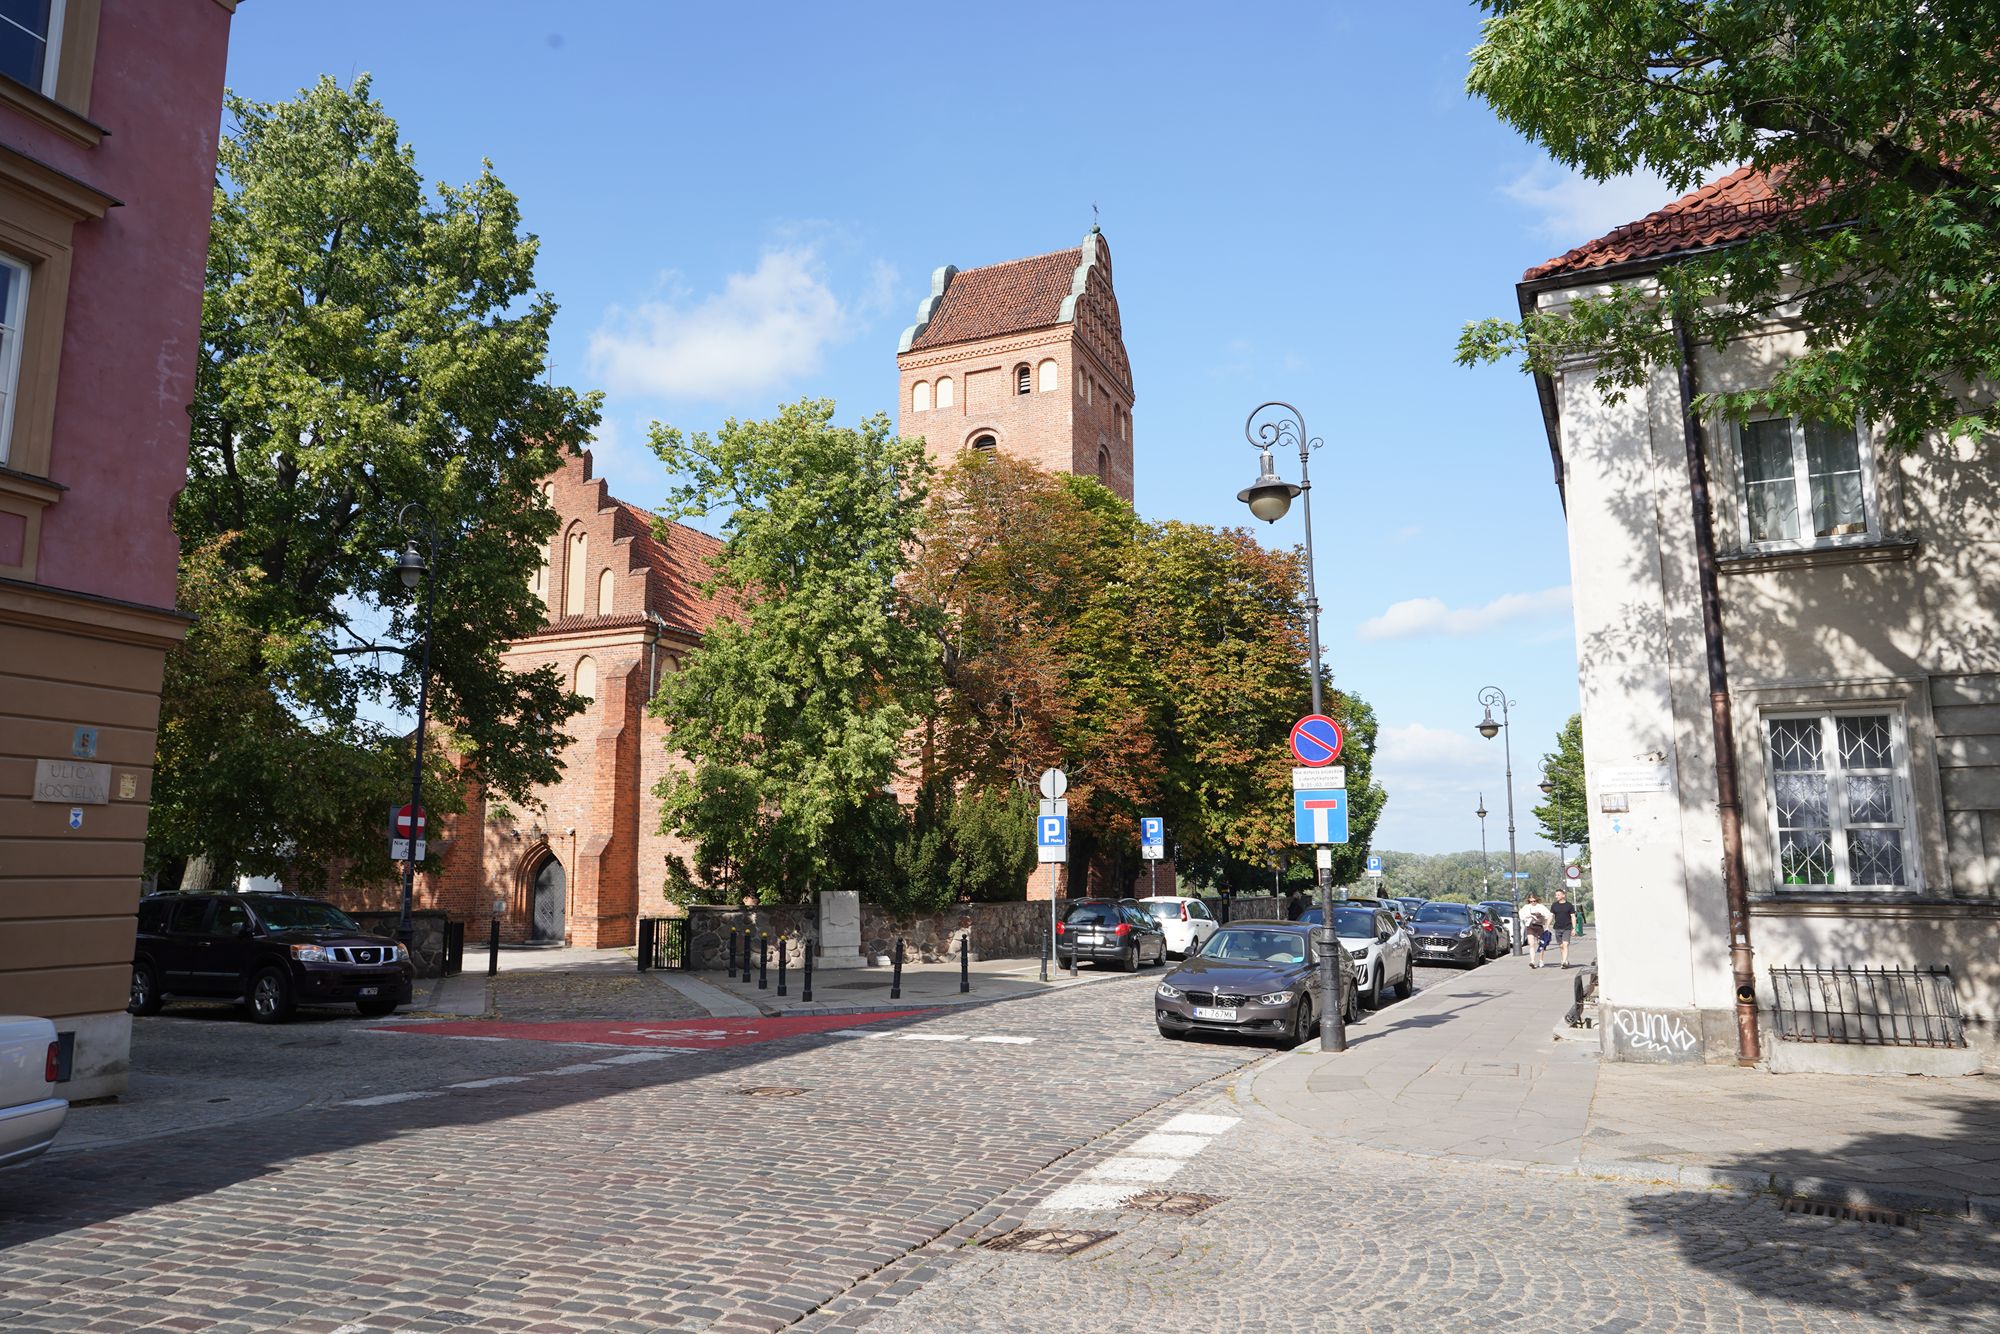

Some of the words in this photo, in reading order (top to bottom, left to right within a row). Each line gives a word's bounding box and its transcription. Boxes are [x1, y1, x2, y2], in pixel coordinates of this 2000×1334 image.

[51, 764, 95, 779] ULICA
[1044, 818, 1060, 843] P
[1146, 820, 1158, 838] P
[1370, 858, 1379, 869] P
